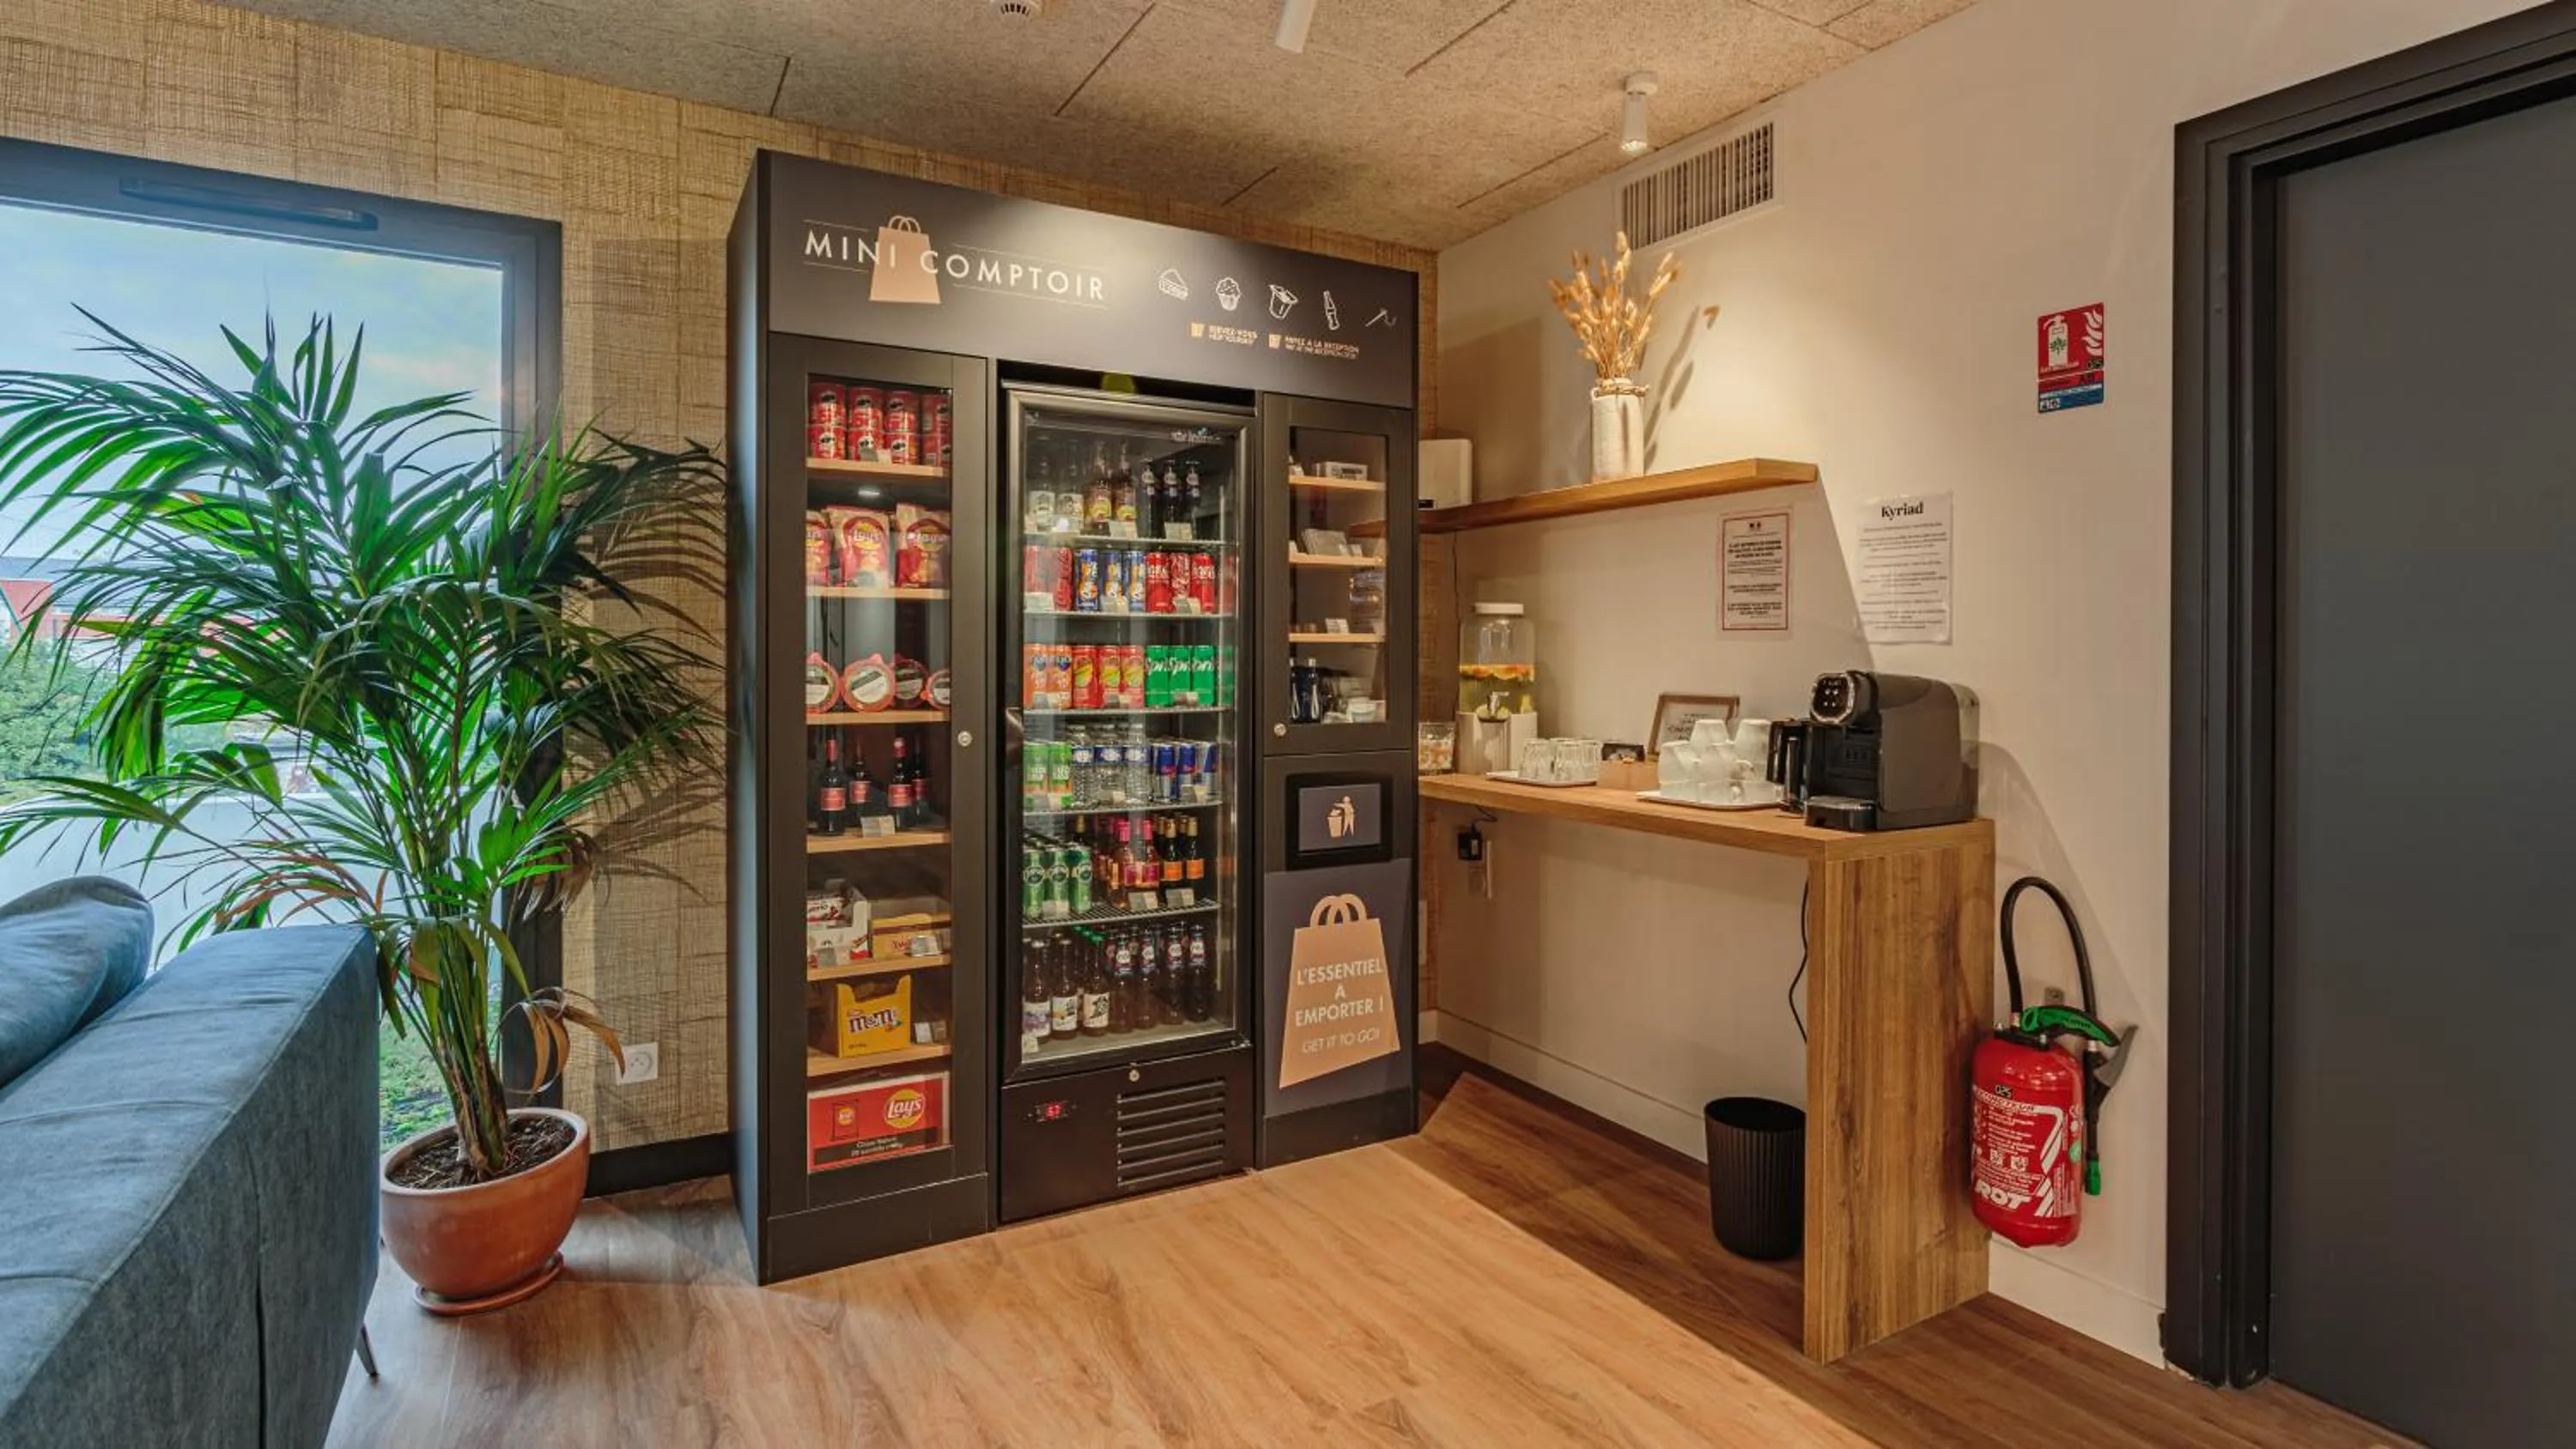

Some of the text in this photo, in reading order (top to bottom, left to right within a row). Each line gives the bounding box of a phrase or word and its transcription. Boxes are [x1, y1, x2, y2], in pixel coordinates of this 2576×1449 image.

[805, 229, 1104, 300] MINI COMPTOIR
[1880, 501, 1923, 520] Kyriad
[1297, 958, 1384, 986] L'ESSENTIEL
[1295, 999, 1374, 1028] EMPORTER
[1302, 1037, 1325, 1054] GET
[1325, 1035, 1337, 1051] IT
[1339, 1033, 1355, 1046] TO
